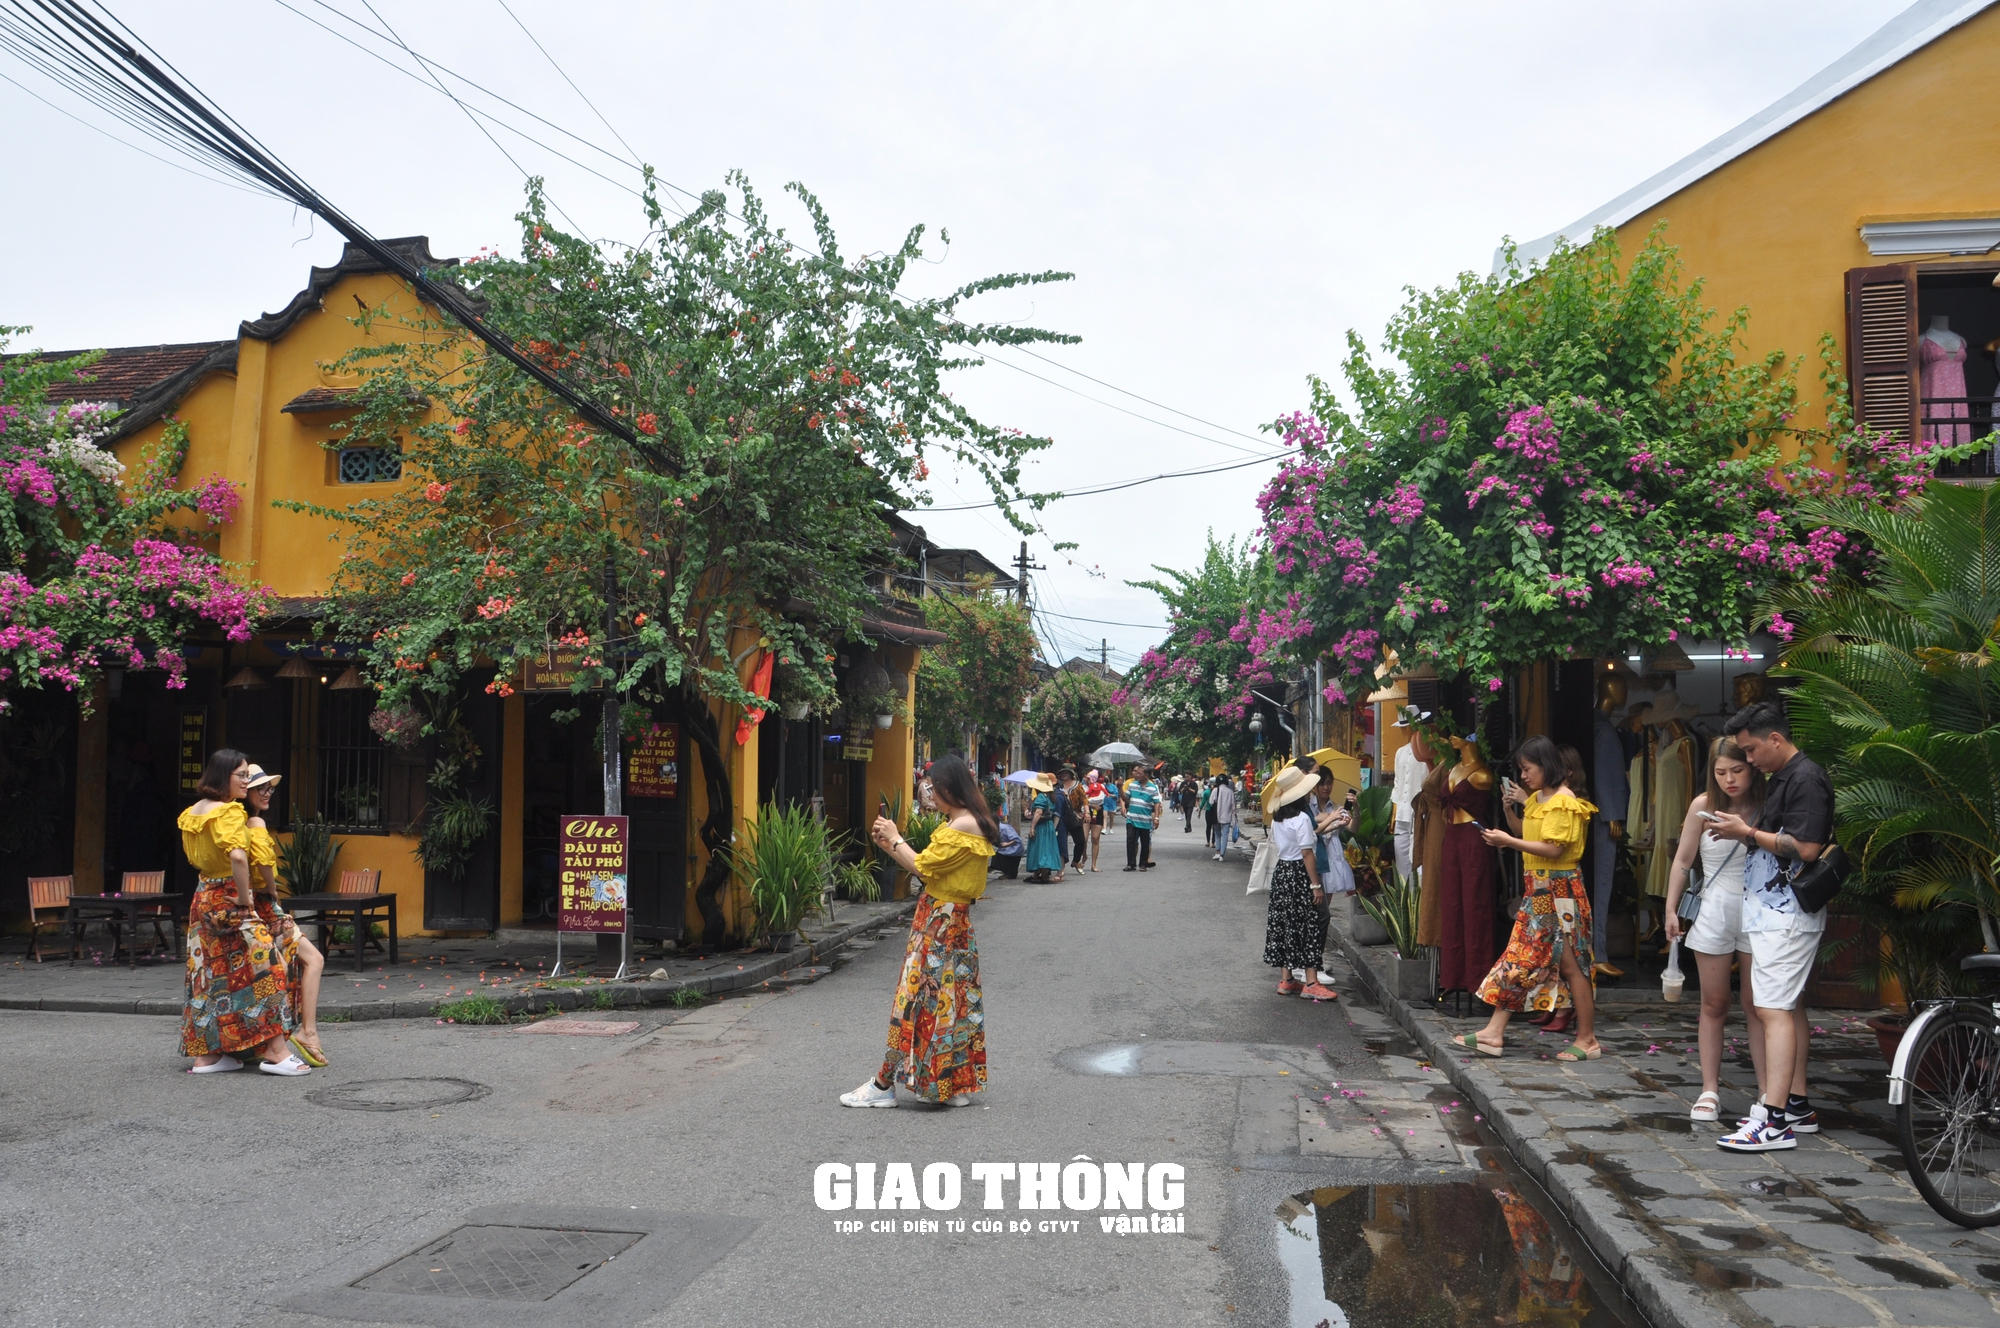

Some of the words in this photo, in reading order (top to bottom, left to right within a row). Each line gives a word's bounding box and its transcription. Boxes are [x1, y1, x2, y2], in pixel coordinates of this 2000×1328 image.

[192, 763, 202, 773] SEN
[565, 820, 620, 839] Chè
[564, 841, 597, 856] ĐẬU
[564, 855, 592, 867] TÀU
[598, 871, 614, 881] SEN
[580, 899, 601, 914] THẬP
[602, 897, 622, 912] CẨM
